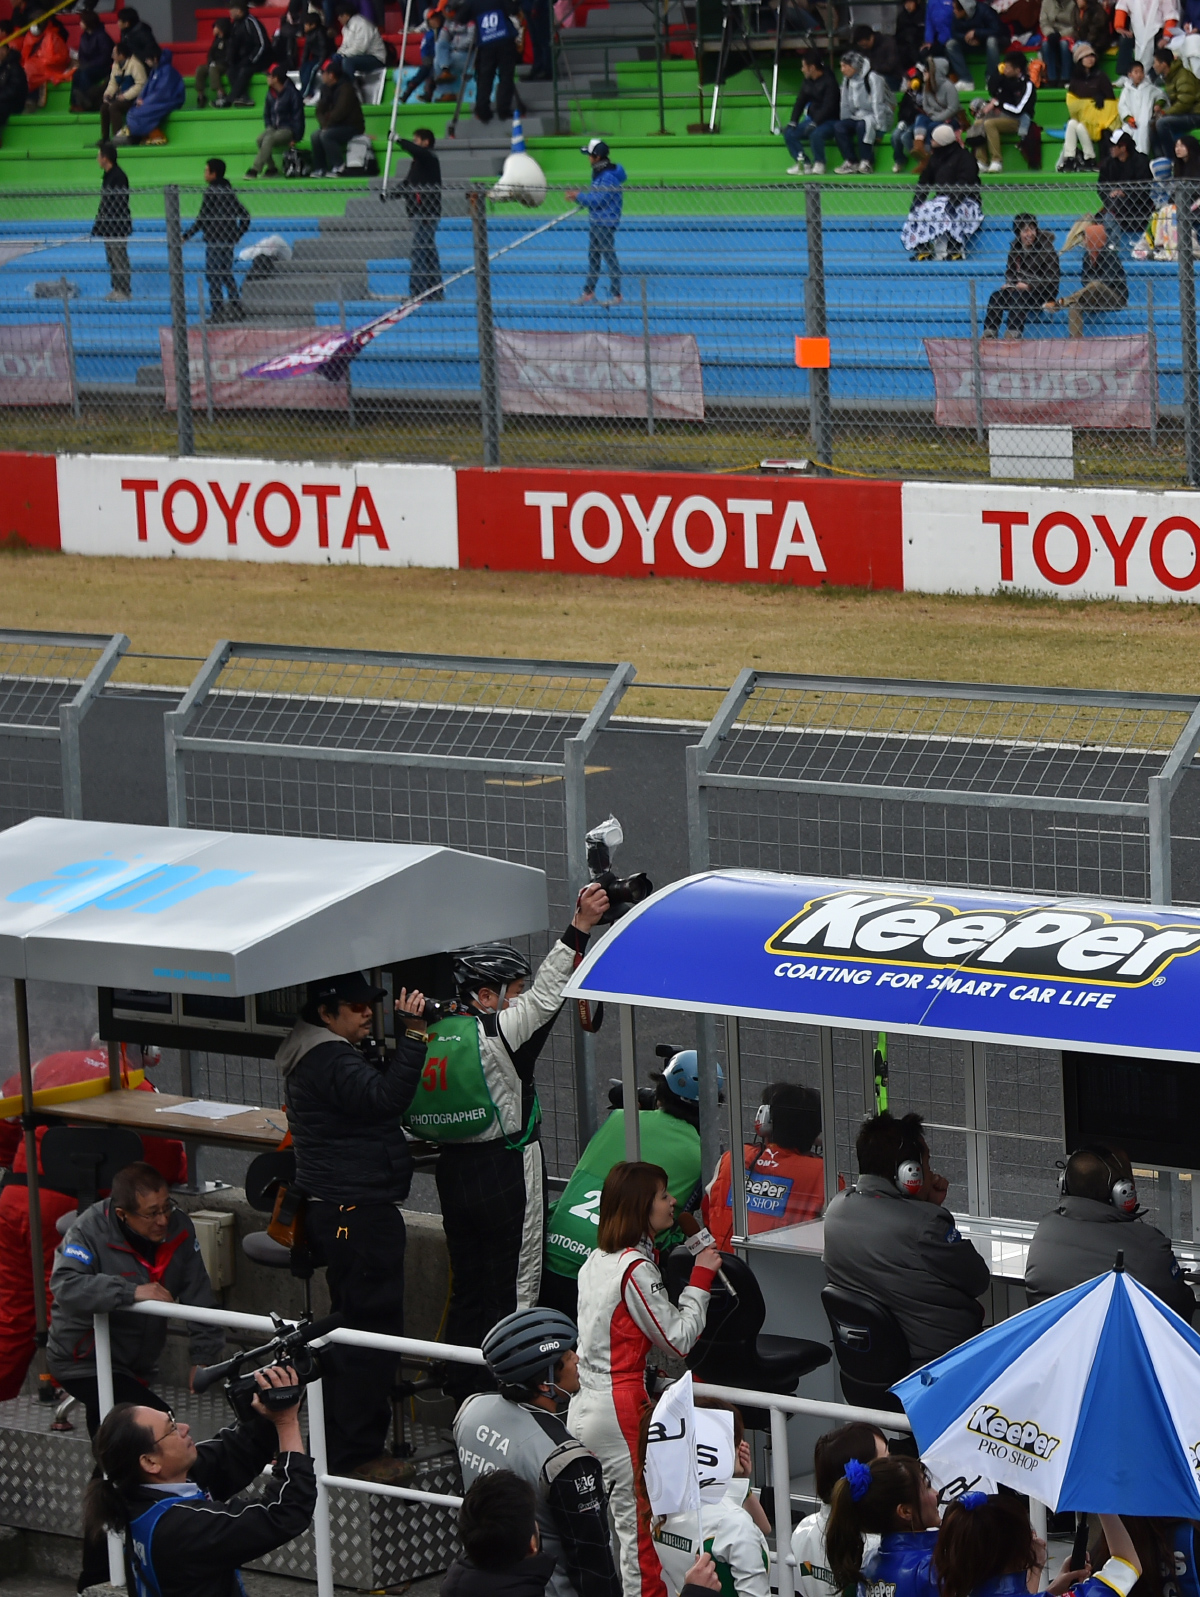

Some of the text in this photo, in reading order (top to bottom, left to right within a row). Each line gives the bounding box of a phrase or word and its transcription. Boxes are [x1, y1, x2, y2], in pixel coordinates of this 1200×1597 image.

[121, 479, 390, 551] TOYOTA
[523, 491, 828, 573] TOYOTA
[773, 962, 1117, 1010] COATING FOR SMART CAR LIFE
[422, 1056, 448, 1092] 51
[410, 1107, 487, 1125] PHOTOGRAPHER
[745, 1181, 786, 1198] eePer
[751, 1198, 780, 1210] SHOP
[539, 1341, 561, 1353] GIRO
[476, 1425, 511, 1456] GTA
[969, 1406, 1059, 1460] KeePer
[978, 1438, 1039, 1472] PRO SHOP
